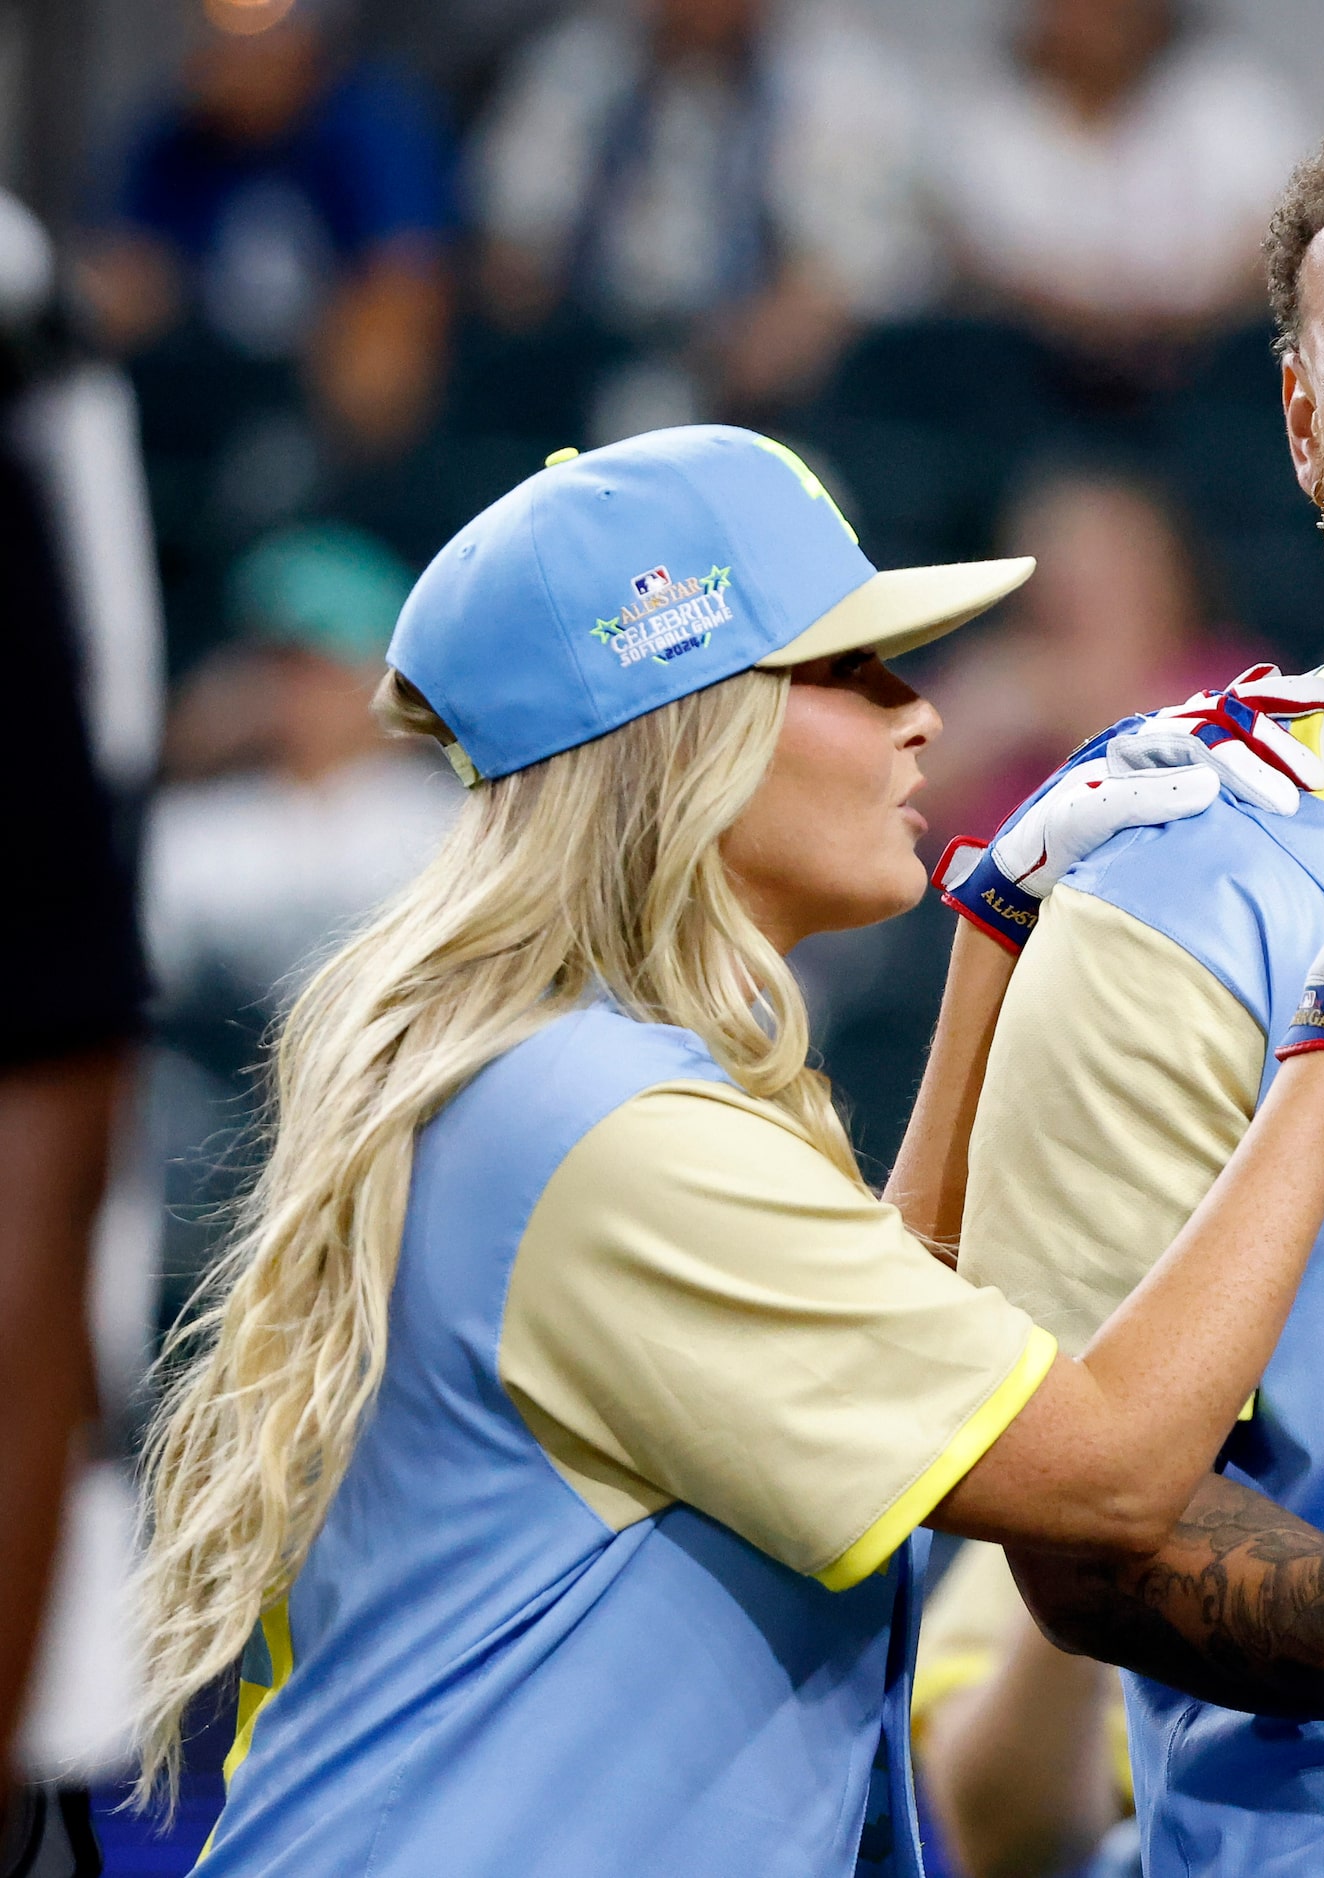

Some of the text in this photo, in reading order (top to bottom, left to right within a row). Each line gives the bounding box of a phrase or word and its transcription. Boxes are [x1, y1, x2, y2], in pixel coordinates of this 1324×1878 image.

[610, 587, 726, 654] CELEBRITY
[620, 607, 734, 667] SOFTBALL GAME
[664, 636, 700, 660] 2024
